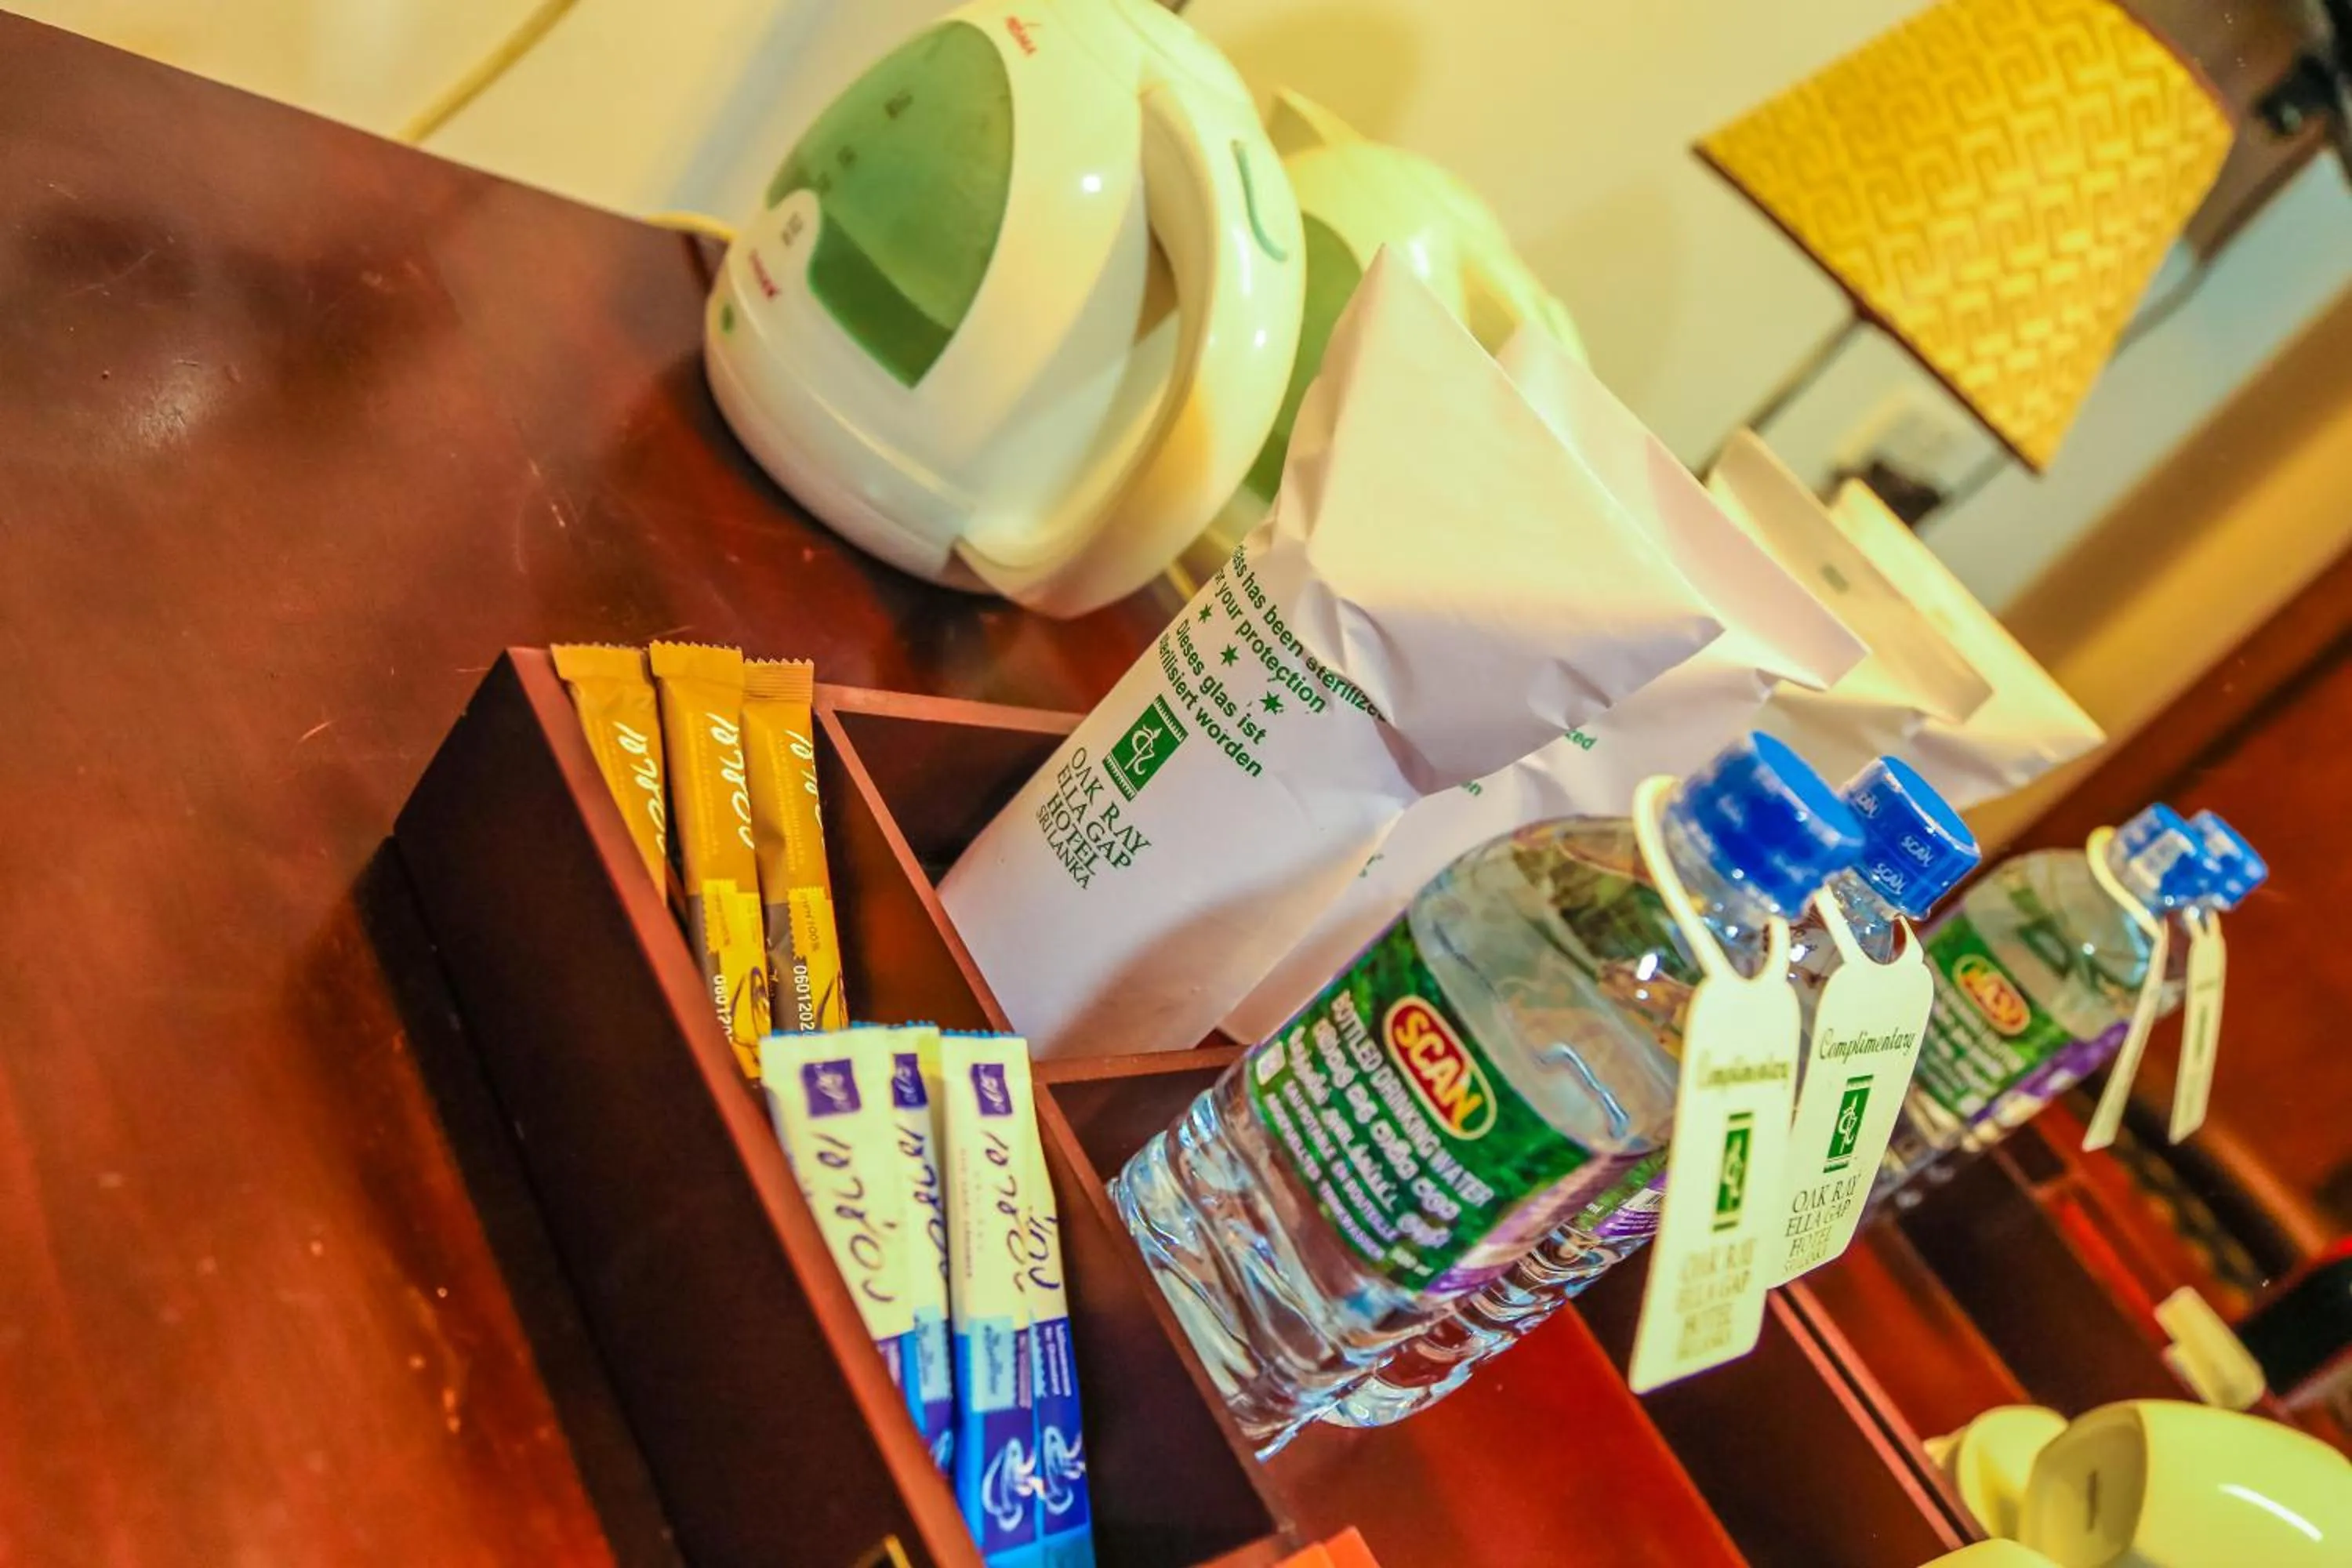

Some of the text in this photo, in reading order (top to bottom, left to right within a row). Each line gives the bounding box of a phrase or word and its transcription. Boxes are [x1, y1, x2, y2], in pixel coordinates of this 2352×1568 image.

[1215, 582, 1243, 620] your
[1235, 620, 1327, 713] protection
[1242, 572, 1266, 609] has
[1263, 604, 1304, 657] been
[1177, 619, 1266, 745] Dieses glas ist
[1196, 707, 1262, 777] worden
[1047, 793, 1099, 876] HOTEL
[1058, 764, 1131, 869] ELLA GAP
[1072, 747, 1152, 855] OAK RAY
[1036, 805, 1090, 889] SRI LANKA
[1874, 863, 1907, 895] SCAN
[1901, 835, 1934, 868] SCAN
[793, 964, 815, 1036] 0601202
[1396, 1011, 1483, 1131] SCAN
[1820, 1026, 1916, 1065] Complimentary
[1331, 989, 1494, 1207] BOTTLED DRINKING WATER
